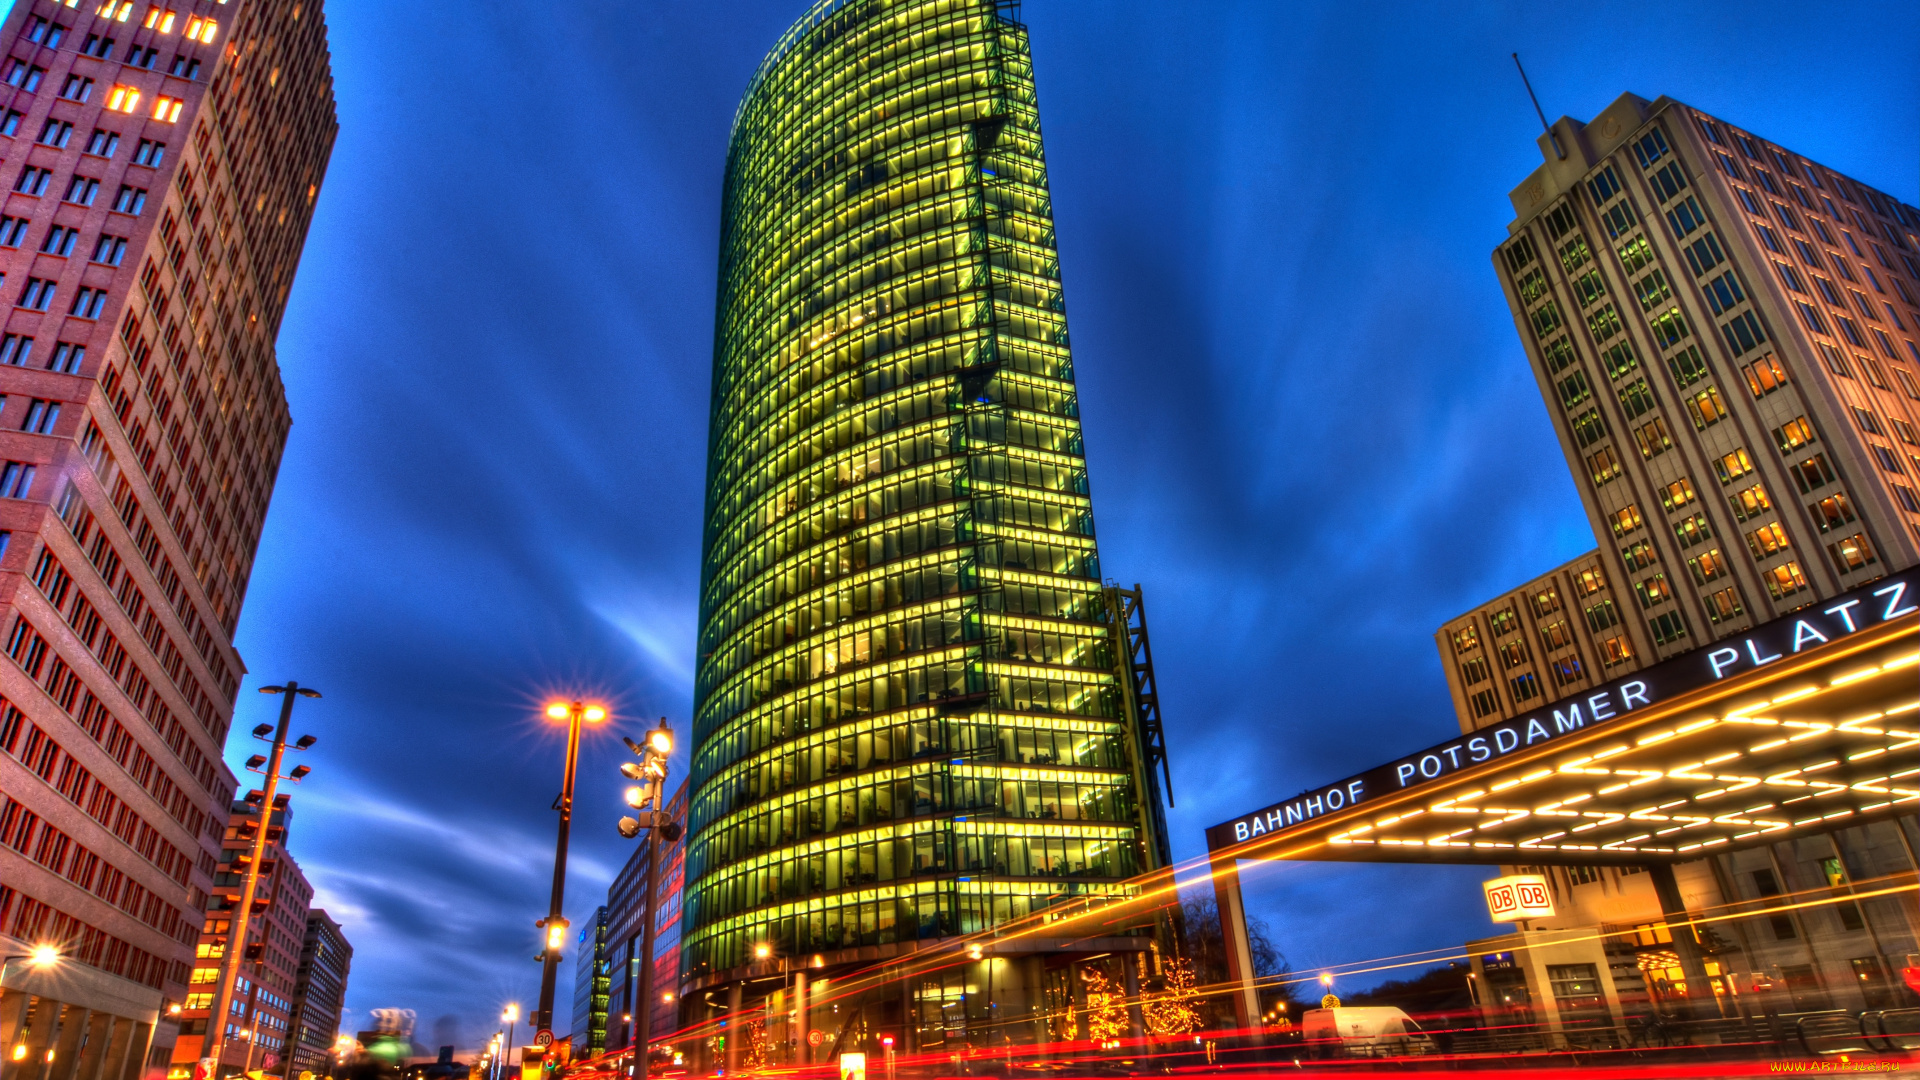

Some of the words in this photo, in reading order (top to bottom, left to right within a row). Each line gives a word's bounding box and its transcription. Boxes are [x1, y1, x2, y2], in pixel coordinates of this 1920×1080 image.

[1234, 780, 1364, 842] BAHNHOF
[1397, 680, 1651, 787] POTSDAMER
[1708, 582, 1919, 679] PLATZ
[1491, 888, 1513, 909] DB
[1520, 887, 1546, 904] DB
[538, 1034, 550, 1045] 30
